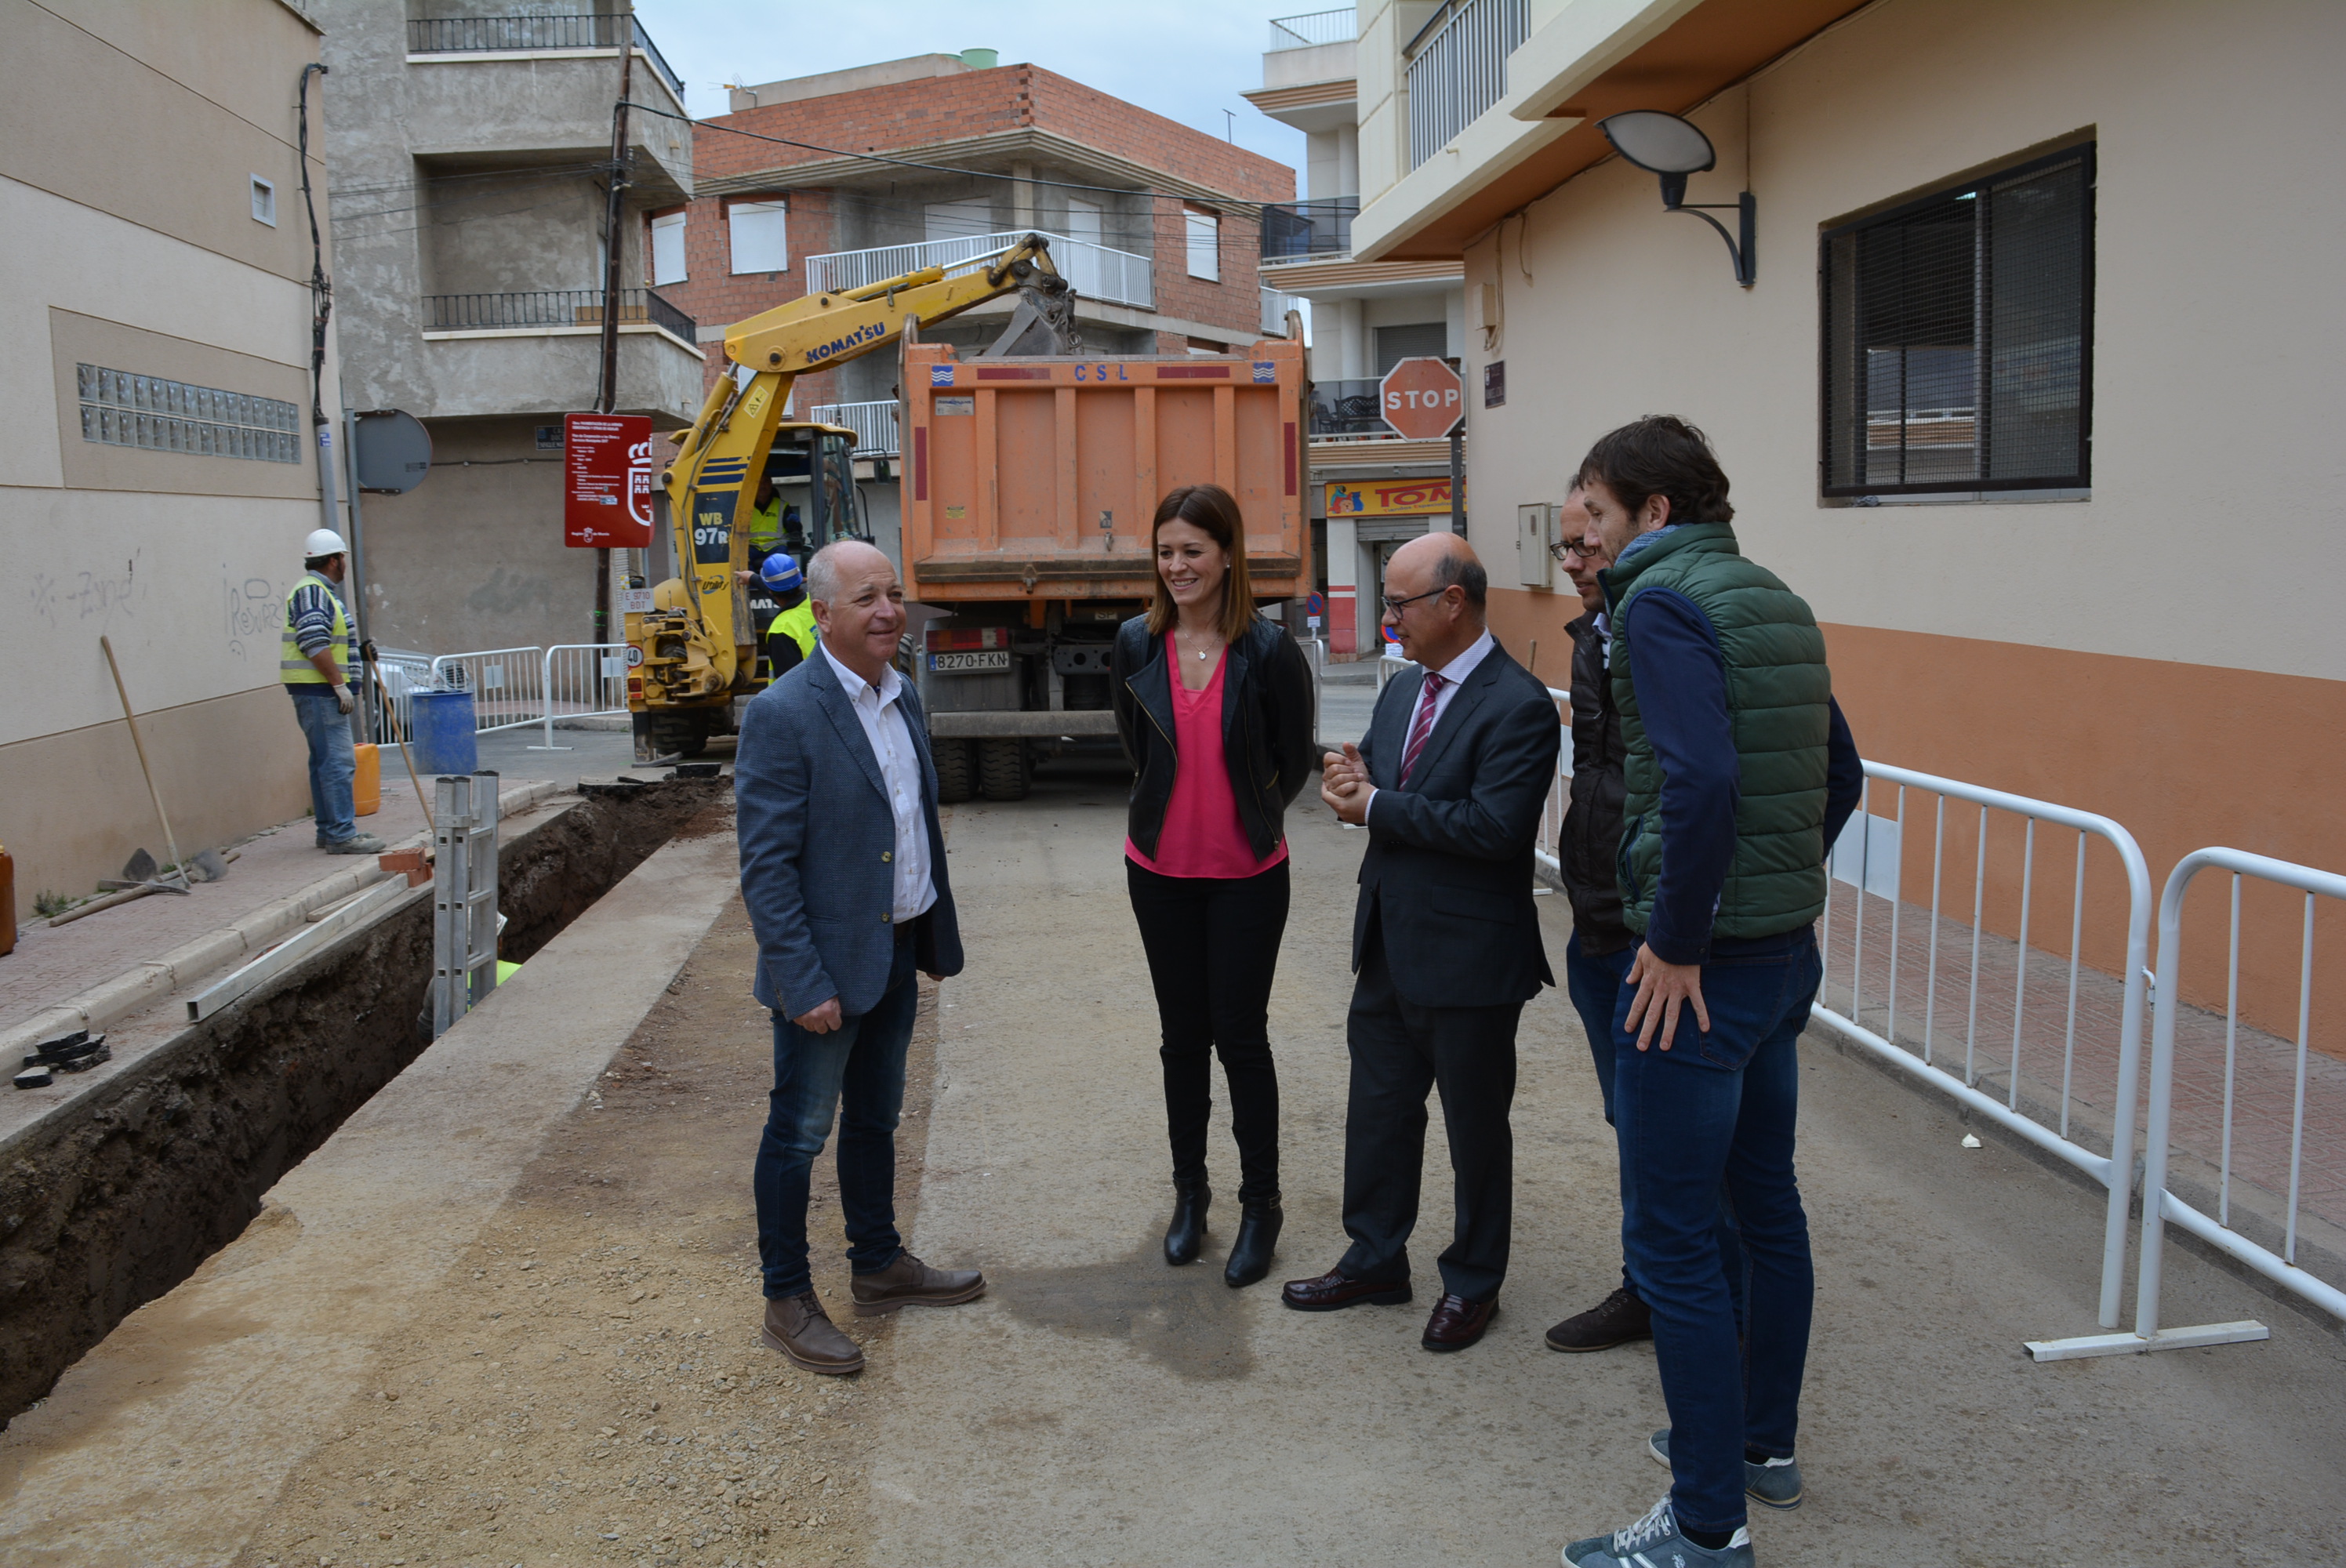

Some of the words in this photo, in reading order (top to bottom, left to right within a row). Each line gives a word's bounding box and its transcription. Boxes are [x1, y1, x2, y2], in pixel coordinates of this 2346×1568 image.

[806, 321, 885, 364] KOMATSU
[1386, 388, 1459, 410] STOP
[1375, 481, 1466, 507] TOM
[699, 512, 723, 526] WB
[694, 528, 728, 546] 97R
[625, 592, 630, 601] E
[628, 649, 638, 663] 40
[938, 654, 974, 669] 8270
[979, 652, 1007, 667] FKN
